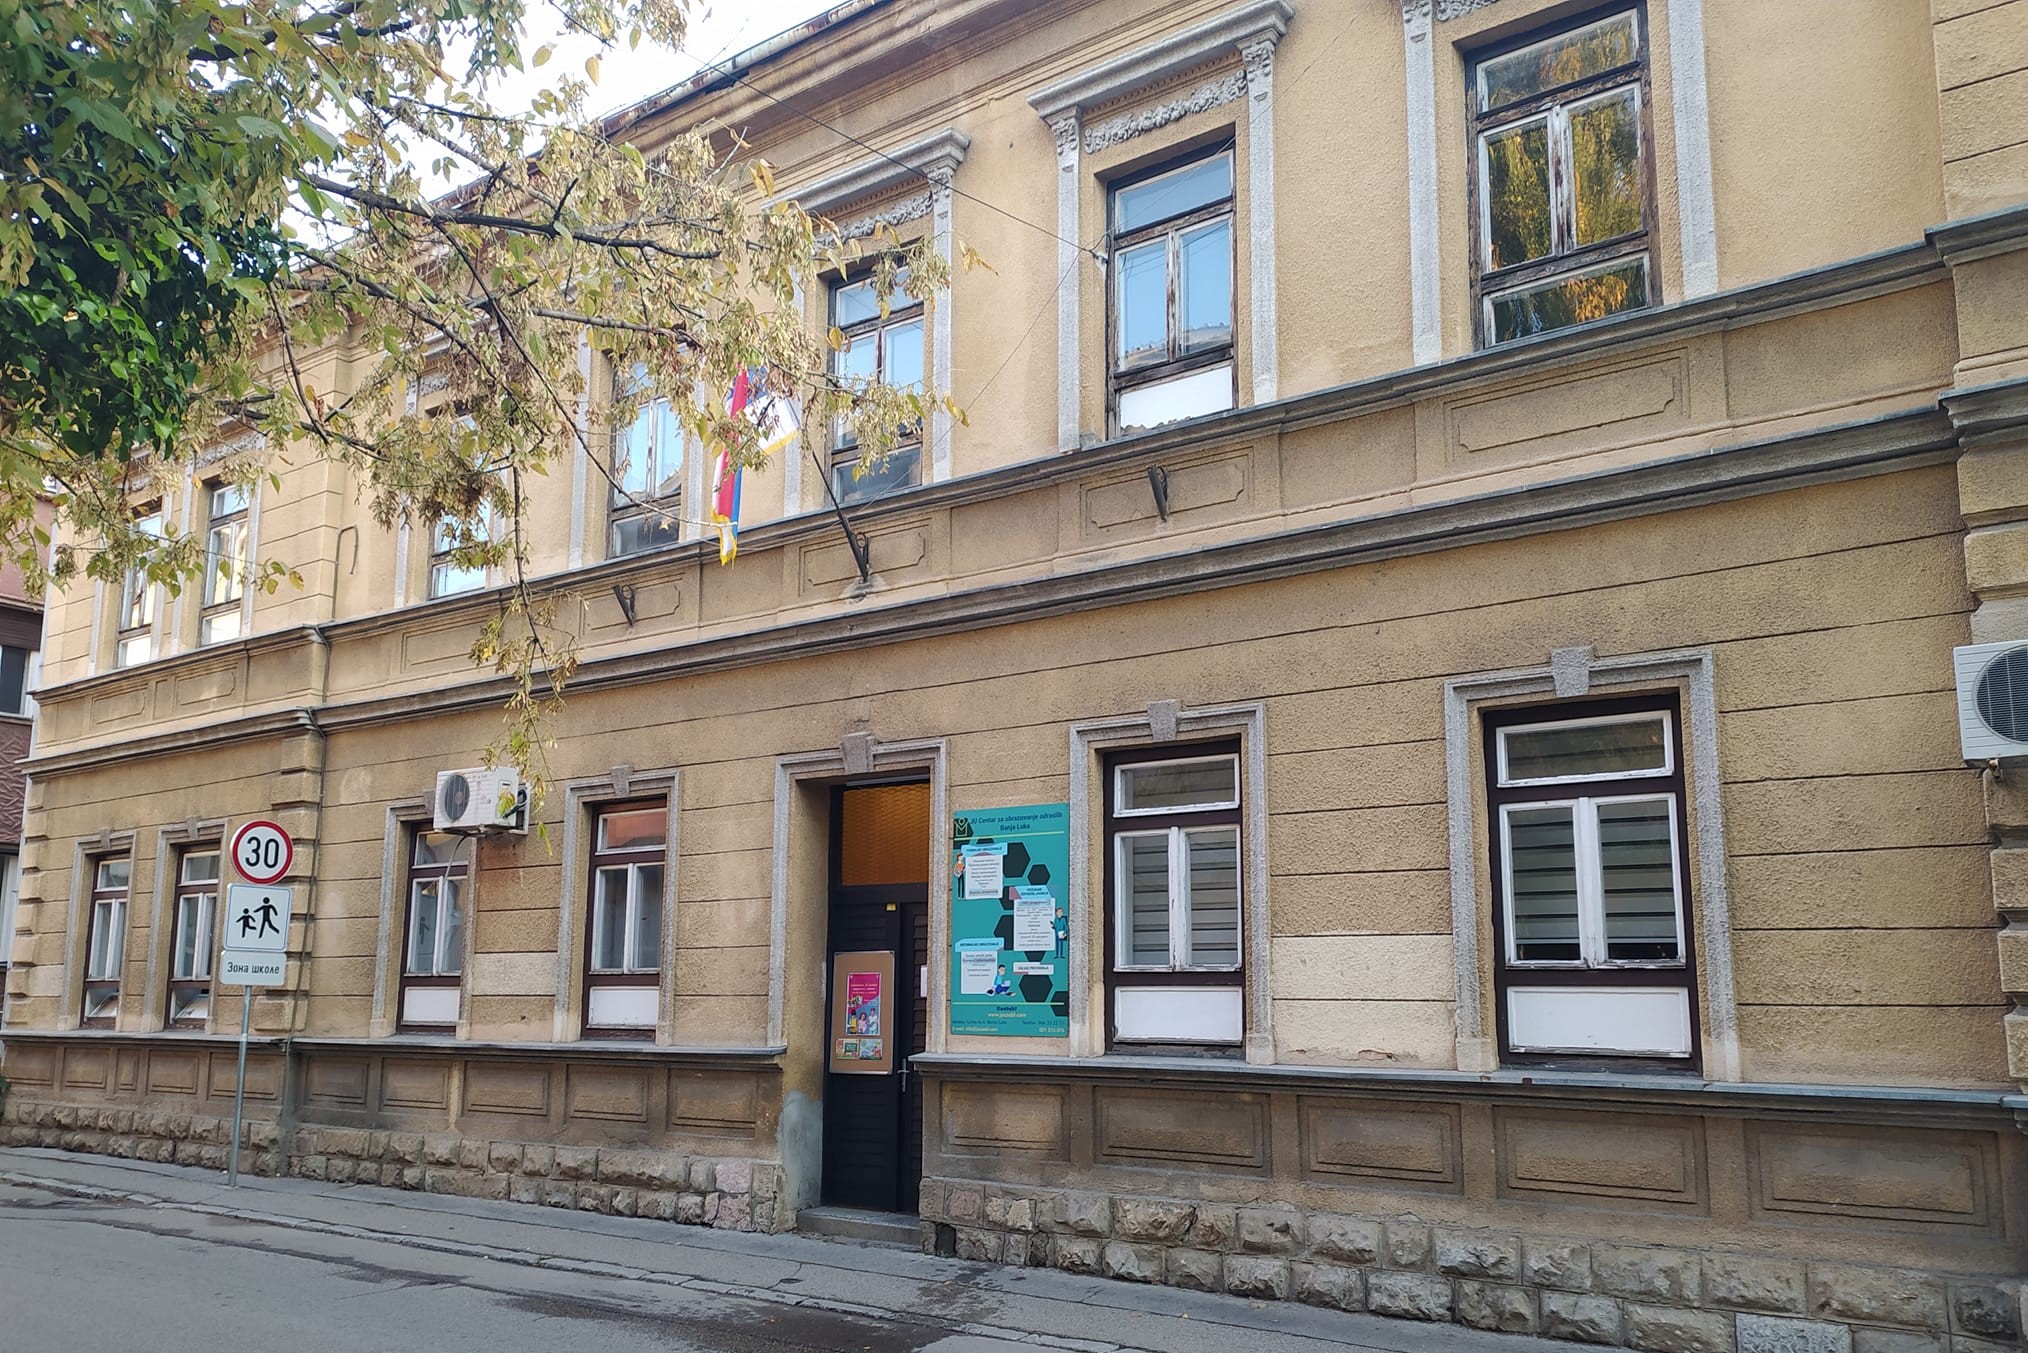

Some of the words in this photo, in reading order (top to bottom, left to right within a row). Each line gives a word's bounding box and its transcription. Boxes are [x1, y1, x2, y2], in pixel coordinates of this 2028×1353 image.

[1005, 814, 1039, 823] obrazovanje
[245, 836, 280, 869] 30
[227, 962, 249, 974] Зона
[252, 962, 280, 975] школе
